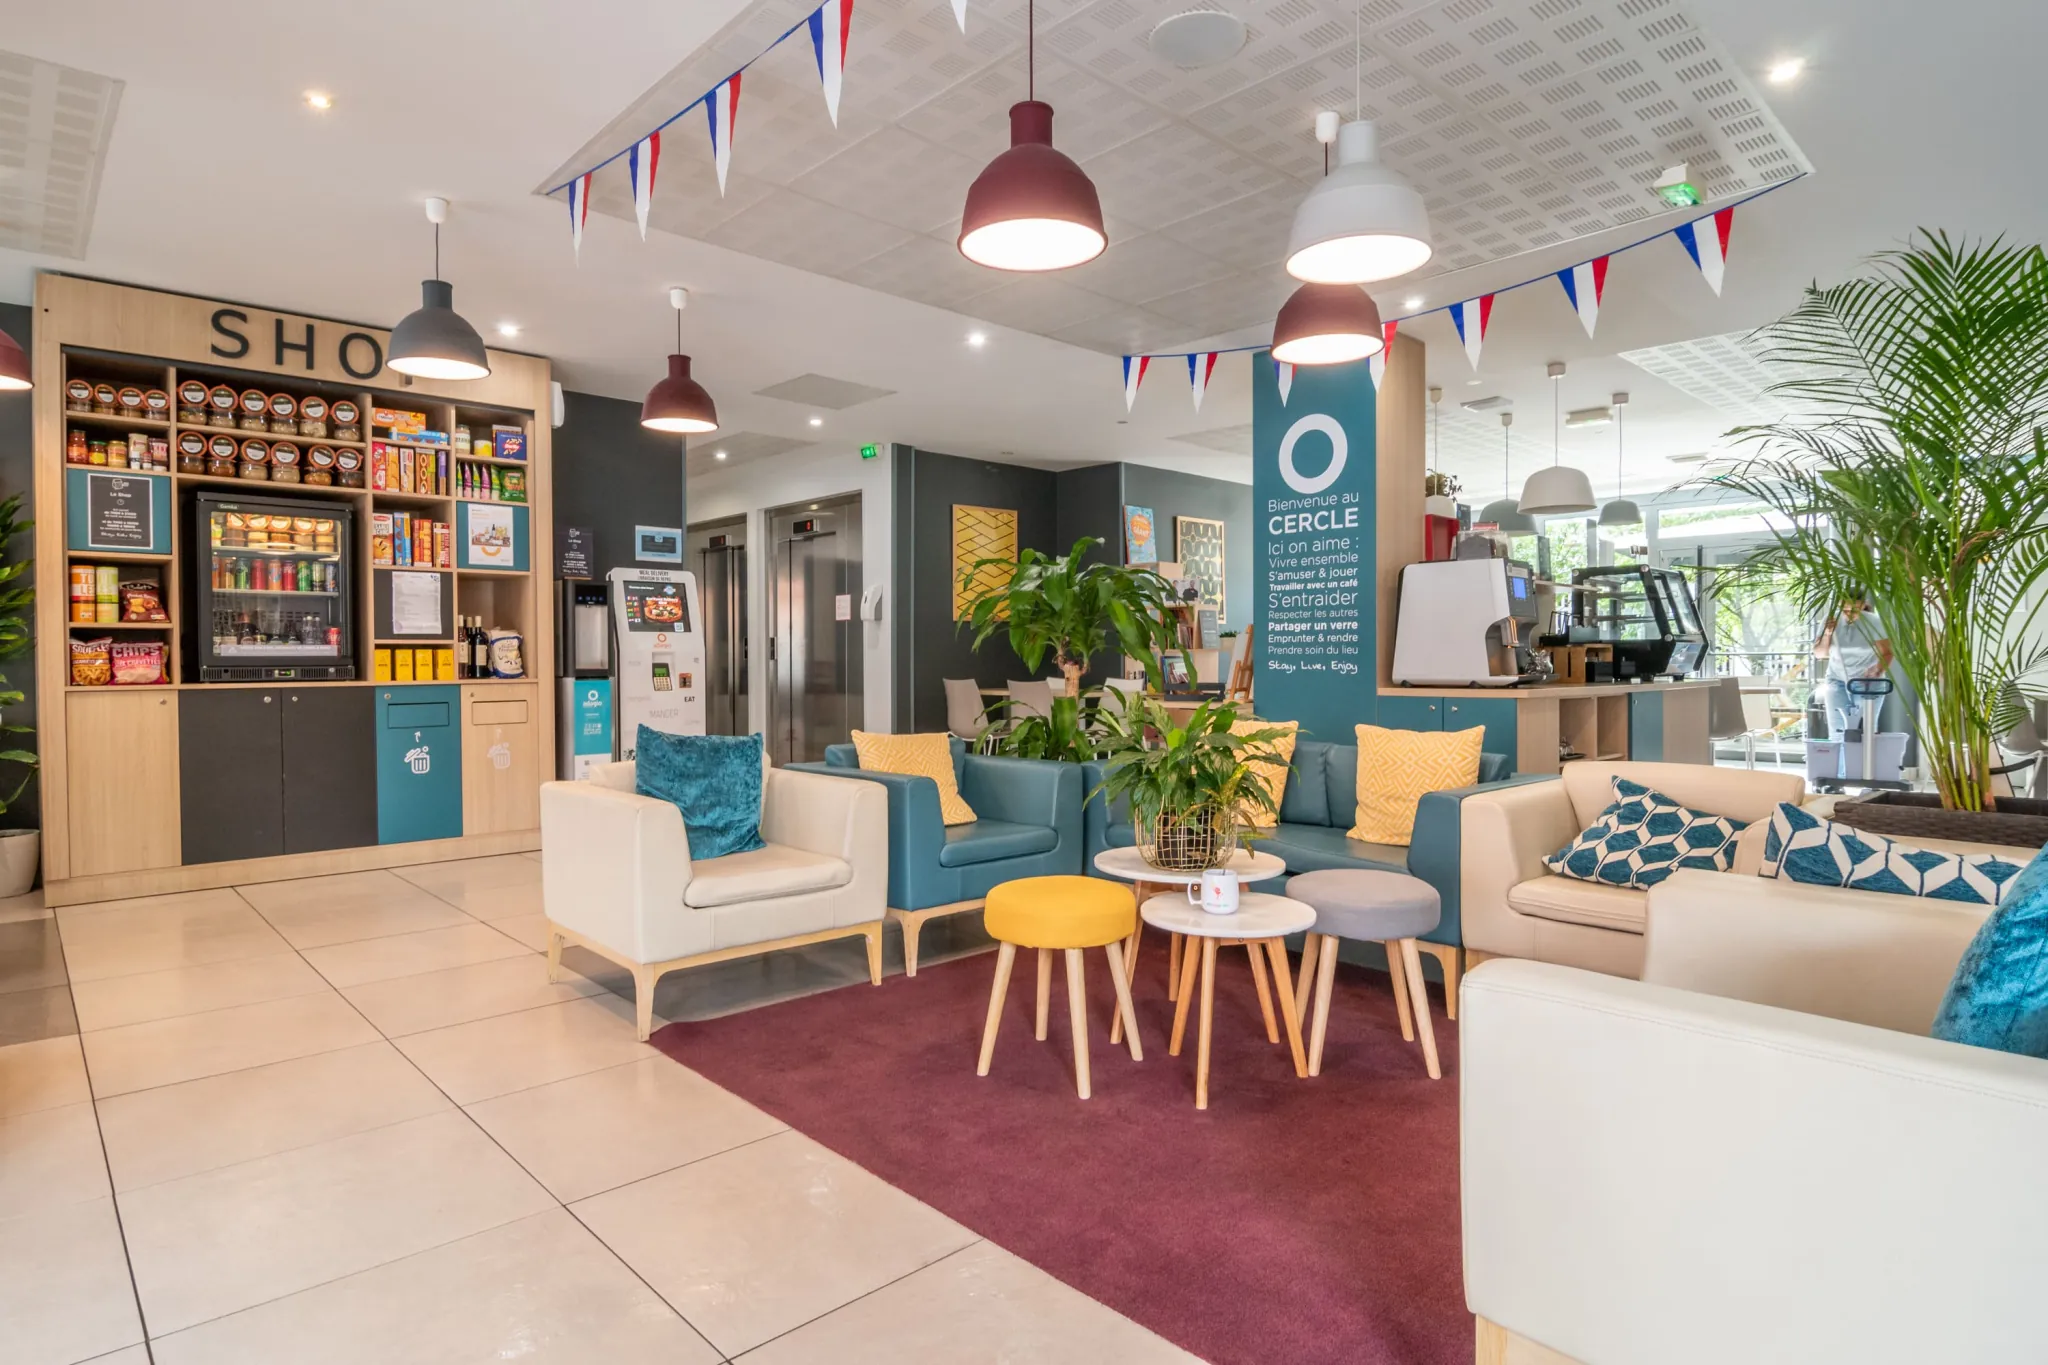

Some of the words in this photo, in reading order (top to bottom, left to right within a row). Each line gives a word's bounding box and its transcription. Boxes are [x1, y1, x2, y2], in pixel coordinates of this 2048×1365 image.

[210, 308, 413, 385] SHO
[1268, 493, 1338, 513] Bienvenue
[1341, 492, 1359, 504] au
[1268, 507, 1359, 535] CERCLE
[1268, 541, 1284, 556] Ici
[1288, 541, 1308, 554] on
[1312, 536, 1351, 552] aime
[1268, 557, 1298, 569] Vivre
[1300, 551, 1359, 567] ensemble
[1268, 570, 1317, 582] S'amuser
[1318, 567, 1327, 579] &
[1329, 566, 1359, 580] jouer
[1269, 582, 1305, 591] Travailler
[1307, 581, 1326, 590] avec
[1327, 580, 1338, 588] un
[1340, 578, 1359, 588] café
[1268, 589, 1359, 608] S’entraider
[1268, 610, 1312, 620] Respecter
[1314, 608, 1327, 618] les
[1329, 608, 1359, 618] autres
[1268, 622, 1312, 632] Partager
[1314, 622, 1327, 630] un
[1330, 621, 1359, 630] verre
[1268, 634, 1316, 644] Emprunter
[1317, 633, 1325, 642] &
[1327, 633, 1359, 642] rendre
[112, 645, 160, 657] CHIPS
[1268, 645, 1303, 655] Prendre
[1305, 645, 1324, 654] soin
[1326, 645, 1339, 654] du
[1341, 645, 1359, 654] lieu
[1268, 660, 1297, 674] Stay,
[1300, 661, 1326, 671] Live,
[1331, 660, 1359, 675] Enjoy
